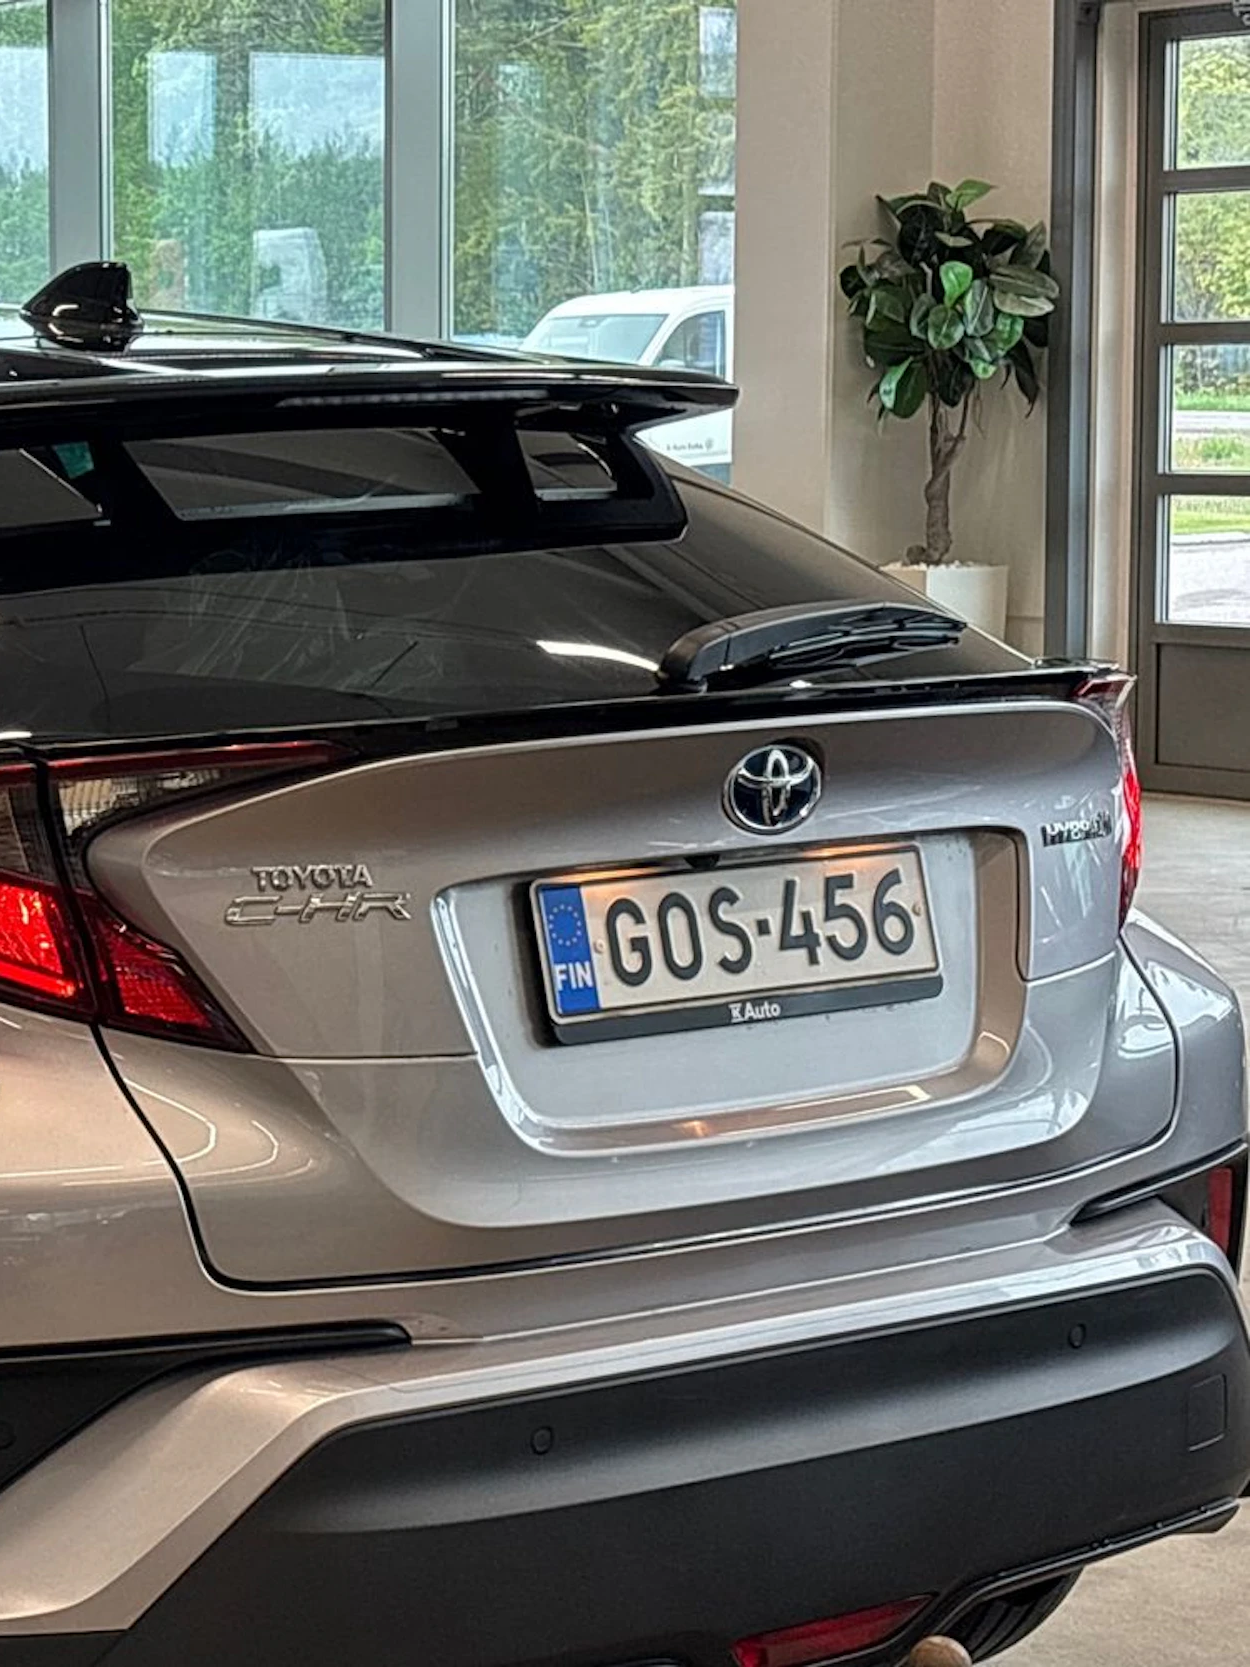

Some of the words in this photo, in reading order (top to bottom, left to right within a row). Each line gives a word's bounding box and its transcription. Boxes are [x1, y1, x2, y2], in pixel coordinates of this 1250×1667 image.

[252, 864, 373, 891] TOYOTA
[224, 892, 412, 926] C-HR
[605, 868, 914, 987] GOS-456
[554, 961, 593, 991] FIN
